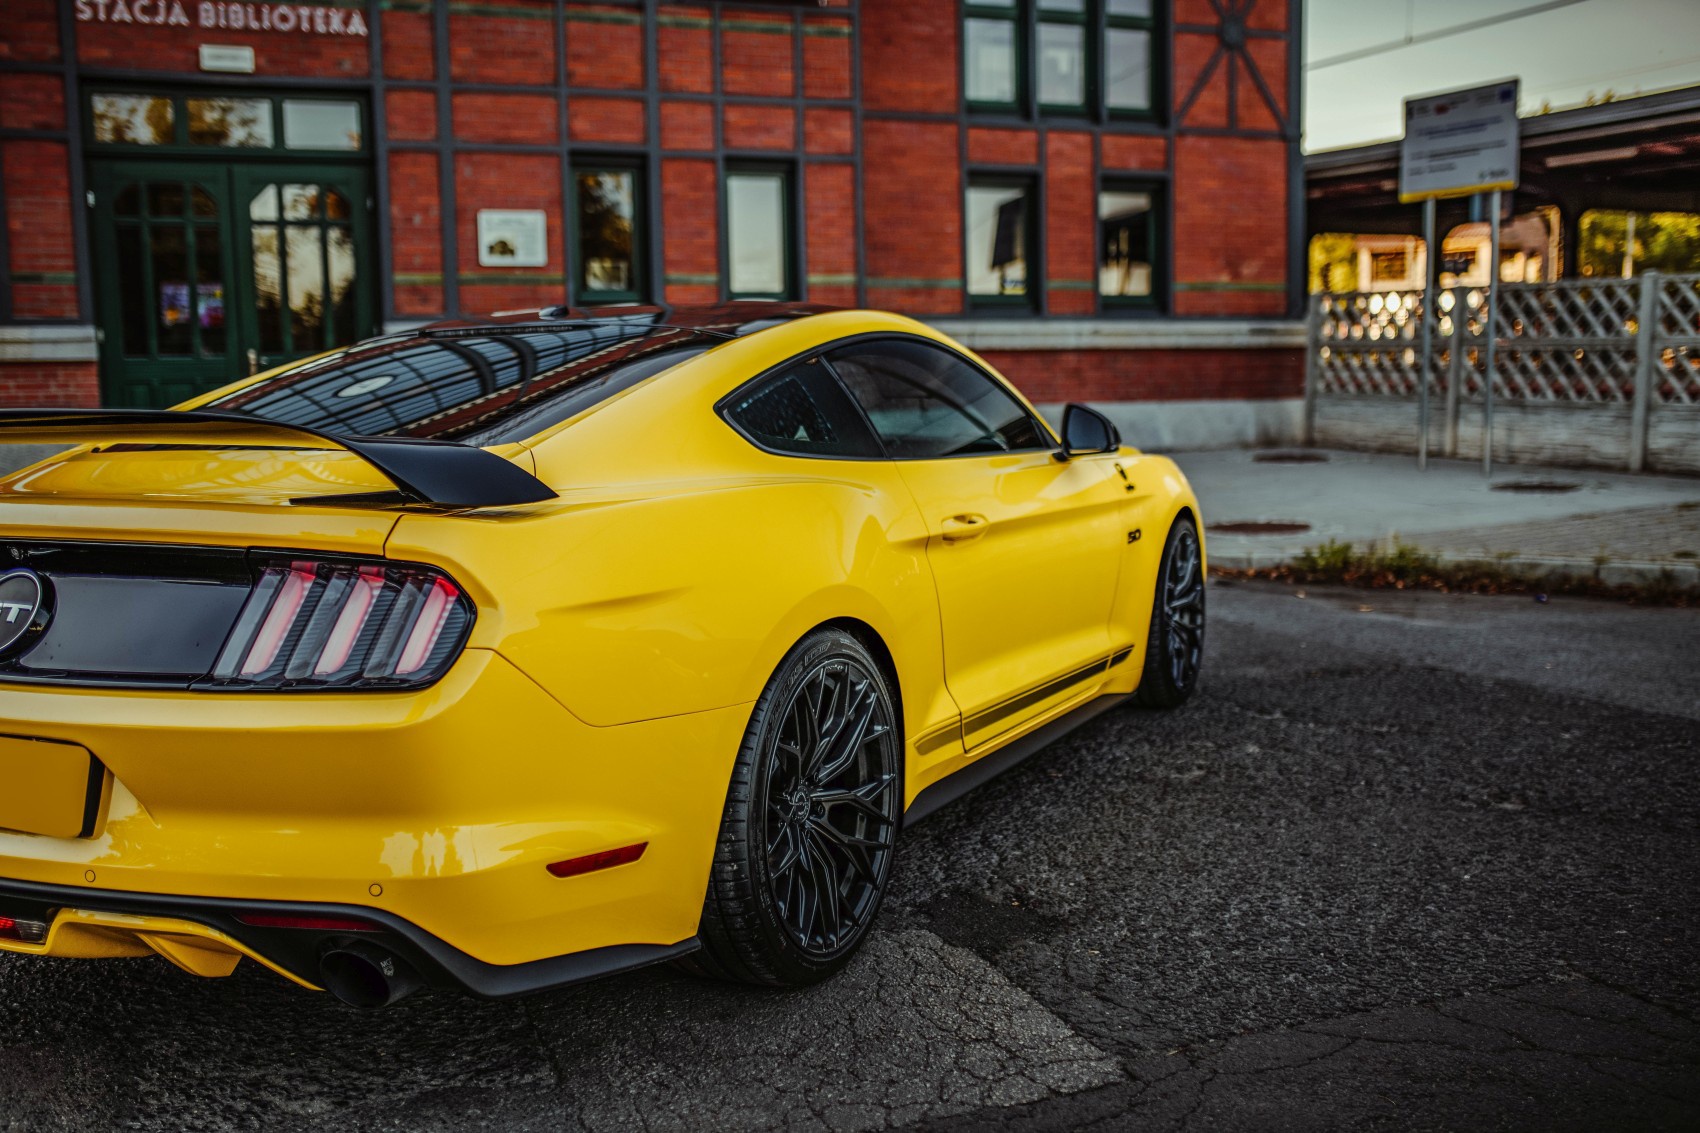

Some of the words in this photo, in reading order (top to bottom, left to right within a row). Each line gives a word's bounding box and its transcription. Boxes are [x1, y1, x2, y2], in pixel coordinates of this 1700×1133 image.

[75, 0, 190, 26] STACJA
[198, 1, 369, 36] BIBLIOTEKA
[0, 602, 33, 623] T
